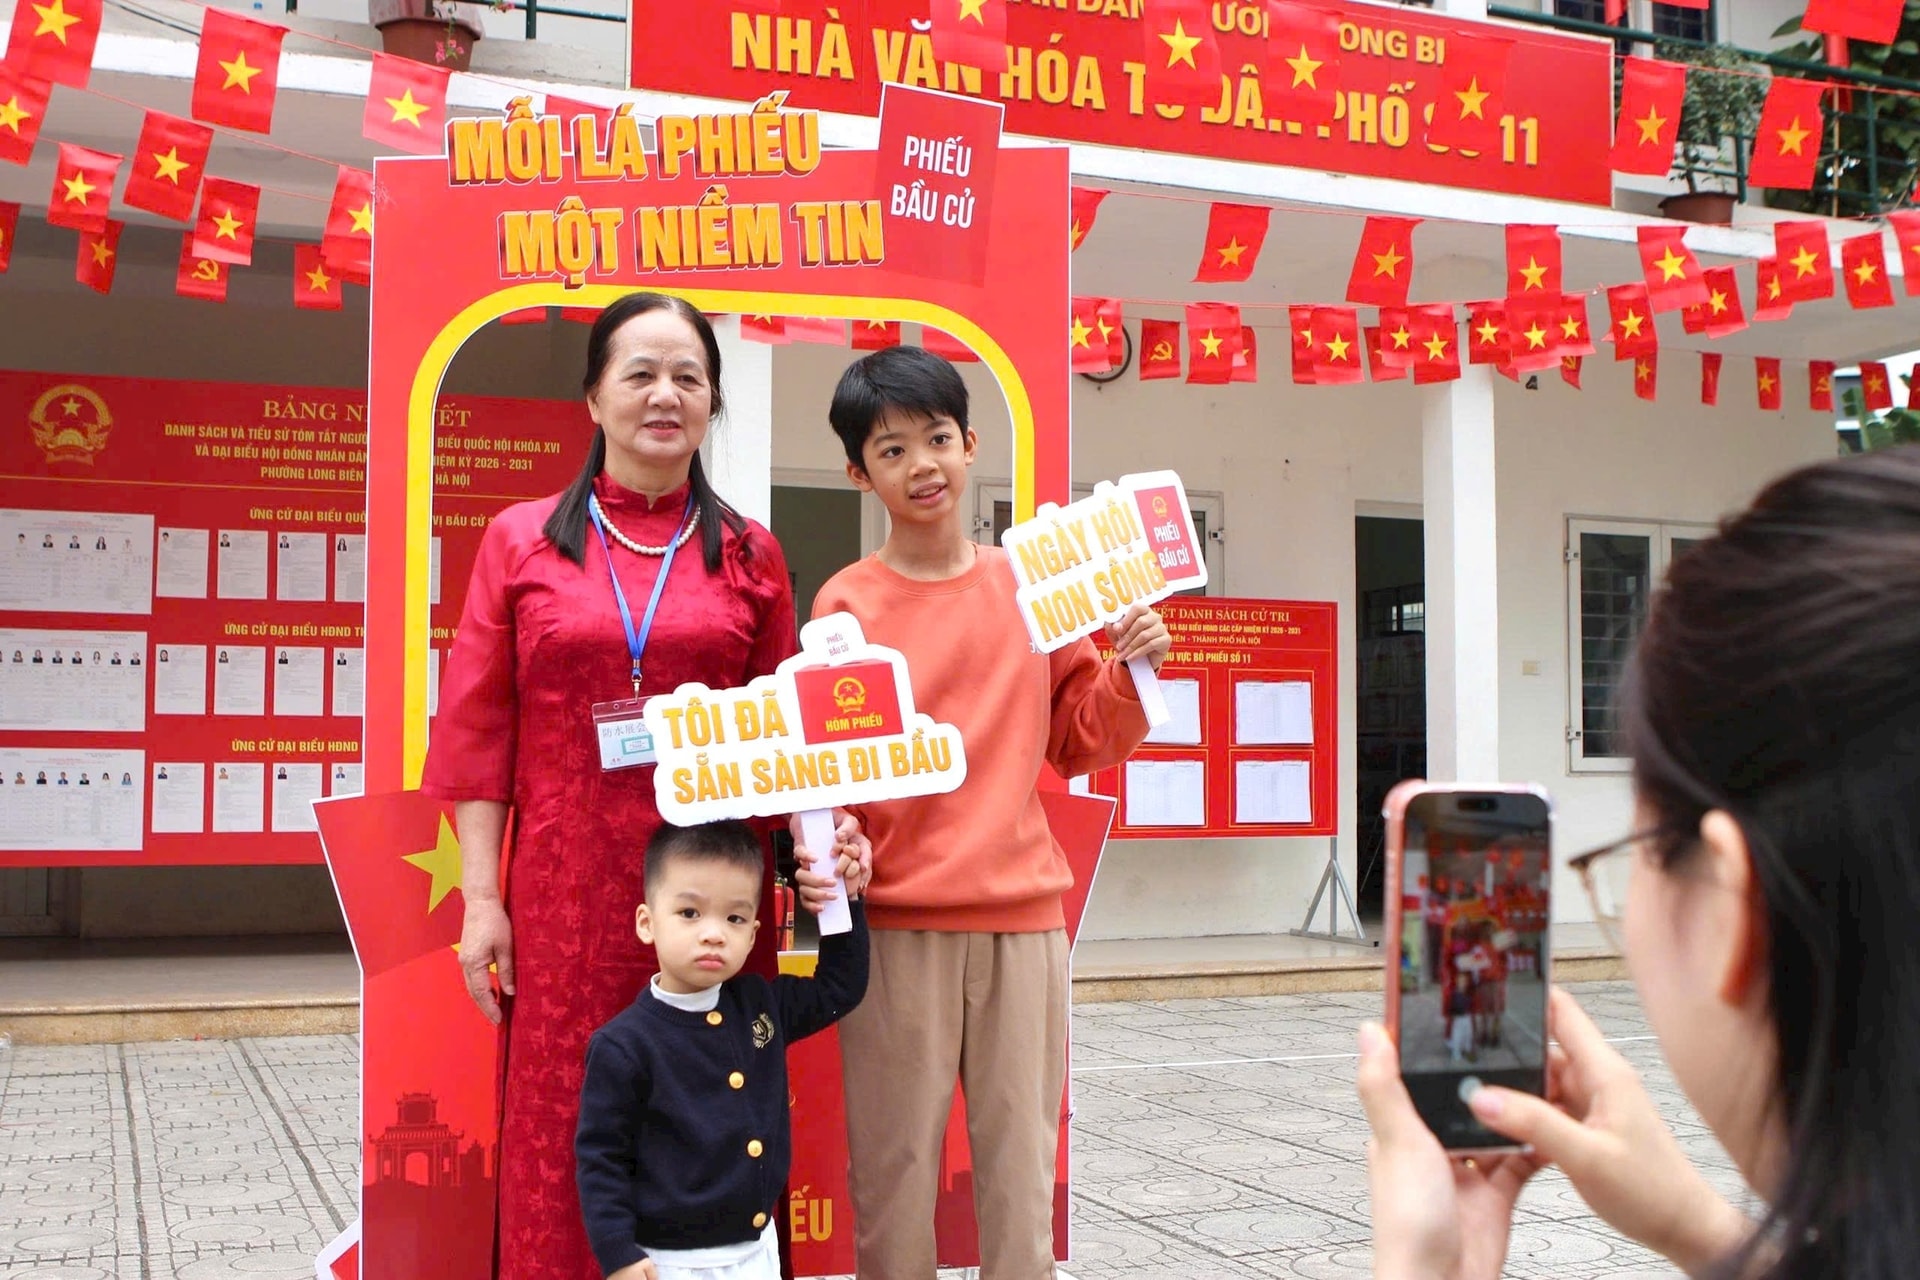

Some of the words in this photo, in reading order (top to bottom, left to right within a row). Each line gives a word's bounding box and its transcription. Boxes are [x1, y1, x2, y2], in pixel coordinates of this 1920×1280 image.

[1338, 22, 1408, 59] ONG
[1416, 35, 1445, 65] BI
[732, 8, 854, 80] NHÀ
[1000, 34, 1106, 110] HÓA
[1500, 114, 1539, 166] 11
[450, 96, 561, 185] MỖI
[572, 103, 647, 182] LÁ
[658, 91, 820, 179] PHIẾU
[903, 135, 972, 177] PHIẾU
[890, 179, 938, 222] BẦU
[943, 187, 976, 229] CỬ
[498, 197, 623, 289] MỘT
[634, 185, 780, 273] NIỀM
[791, 200, 884, 267] TIN
[264, 395, 337, 421] BẢNG
[436, 403, 471, 427] ẾT
[165, 424, 195, 437] DANH
[198, 424, 228, 439] SÁCH
[231, 426, 245, 439] VÀ
[195, 444, 209, 457] VÀ
[212, 446, 231, 459] ĐẠI
[234, 442, 259, 459] BIỂU
[262, 447, 280, 462] HỘI
[315, 448, 345, 463] NHÂN
[437, 433, 460, 449] BIỂU
[464, 435, 491, 450] QUỐC
[494, 438, 511, 453] HỘI
[514, 439, 541, 453] KHÓA
[544, 442, 560, 454] XVI
[261, 465, 305, 480] PHƯỜNG
[308, 468, 336, 481] LONG
[339, 467, 364, 482] BIÊN
[475, 457, 499, 469] 2026
[509, 459, 533, 470] 2031
[435, 472, 449, 485] HÀ
[452, 472, 470, 488] NỘI
[250, 506, 273, 520] ỨNG
[276, 507, 293, 521] CỬ
[294, 509, 313, 523] ĐẠI
[317, 507, 342, 522] BIỂU
[345, 509, 367, 523] QUỐ
[1016, 517, 1092, 585] NGÀY
[1090, 497, 1141, 554] HỘI
[1153, 520, 1180, 543] PHIẾU
[1031, 581, 1097, 642] NON
[1093, 551, 1167, 613] SÔNG
[1179, 608, 1213, 619] DANH
[1216, 606, 1247, 620] SÁCH
[1251, 607, 1268, 621] CỬ
[1270, 611, 1289, 622] TRI
[225, 621, 248, 635] ỨNG
[251, 621, 268, 635] CỬ
[270, 624, 288, 637] ĐẠI
[292, 622, 317, 636] BIỂU
[321, 626, 351, 637] HĐND
[1172, 634, 1186, 642] IÊN
[1206, 650, 1229, 662] PHIẾU
[1243, 654, 1251, 663] 11
[662, 696, 726, 749] TÔI
[734, 689, 789, 741] ĐÃ
[825, 715, 849, 732] HÒM
[852, 712, 883, 730] PHIẾU
[231, 738, 255, 752] ỨNG
[259, 738, 275, 752] CỬ
[277, 741, 296, 754] ĐẠI
[299, 737, 324, 752] BIỂU
[328, 741, 358, 752] HĐND
[672, 752, 743, 804] SẴN
[751, 749, 840, 794] SÀNG
[847, 745, 881, 782] ĐI
[888, 727, 951, 777] BẦU
